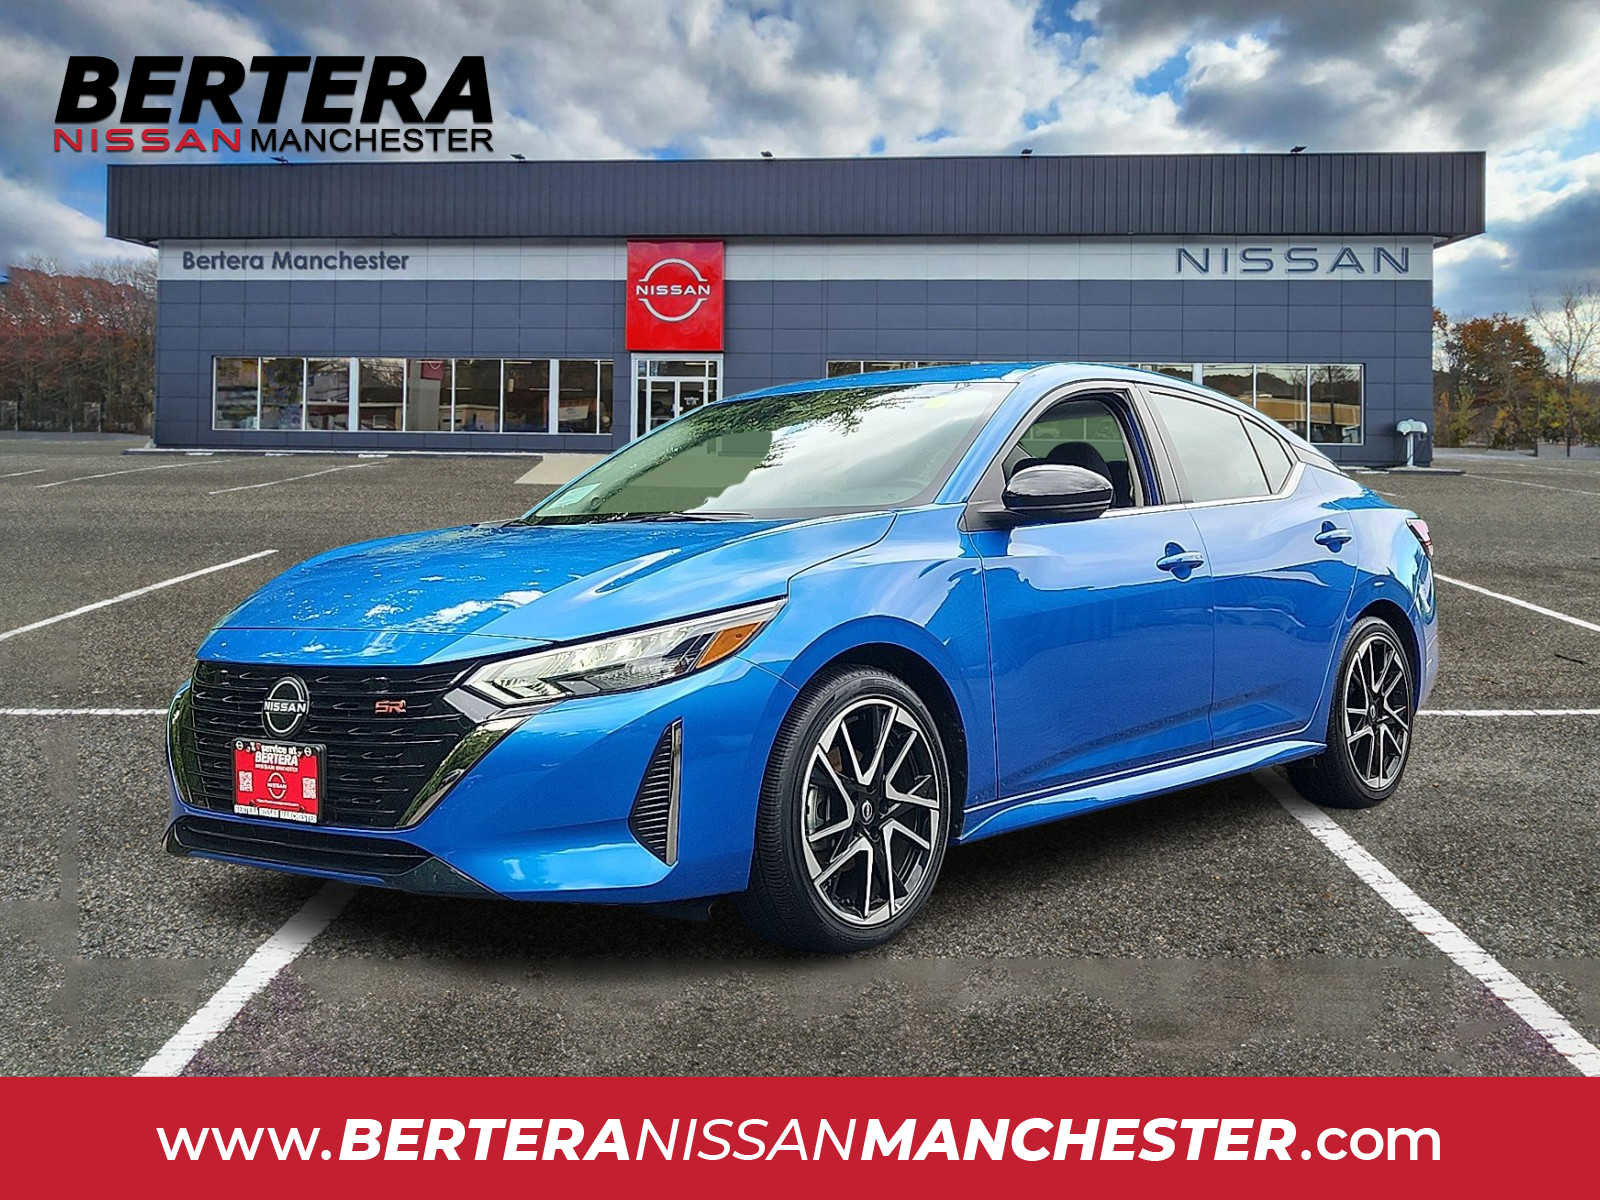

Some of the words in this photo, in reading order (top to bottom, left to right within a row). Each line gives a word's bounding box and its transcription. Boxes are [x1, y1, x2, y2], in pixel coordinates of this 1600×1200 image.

[182, 250, 264, 271] Bertera
[272, 250, 409, 271] Manchester
[1175, 246, 1411, 275] NISSAN
[635, 284, 711, 296] NISSAN
[263, 700, 307, 713] NISSAN
[374, 699, 407, 714] SR
[255, 751, 299, 767] BERTERA
[267, 781, 287, 789] NISSAN
